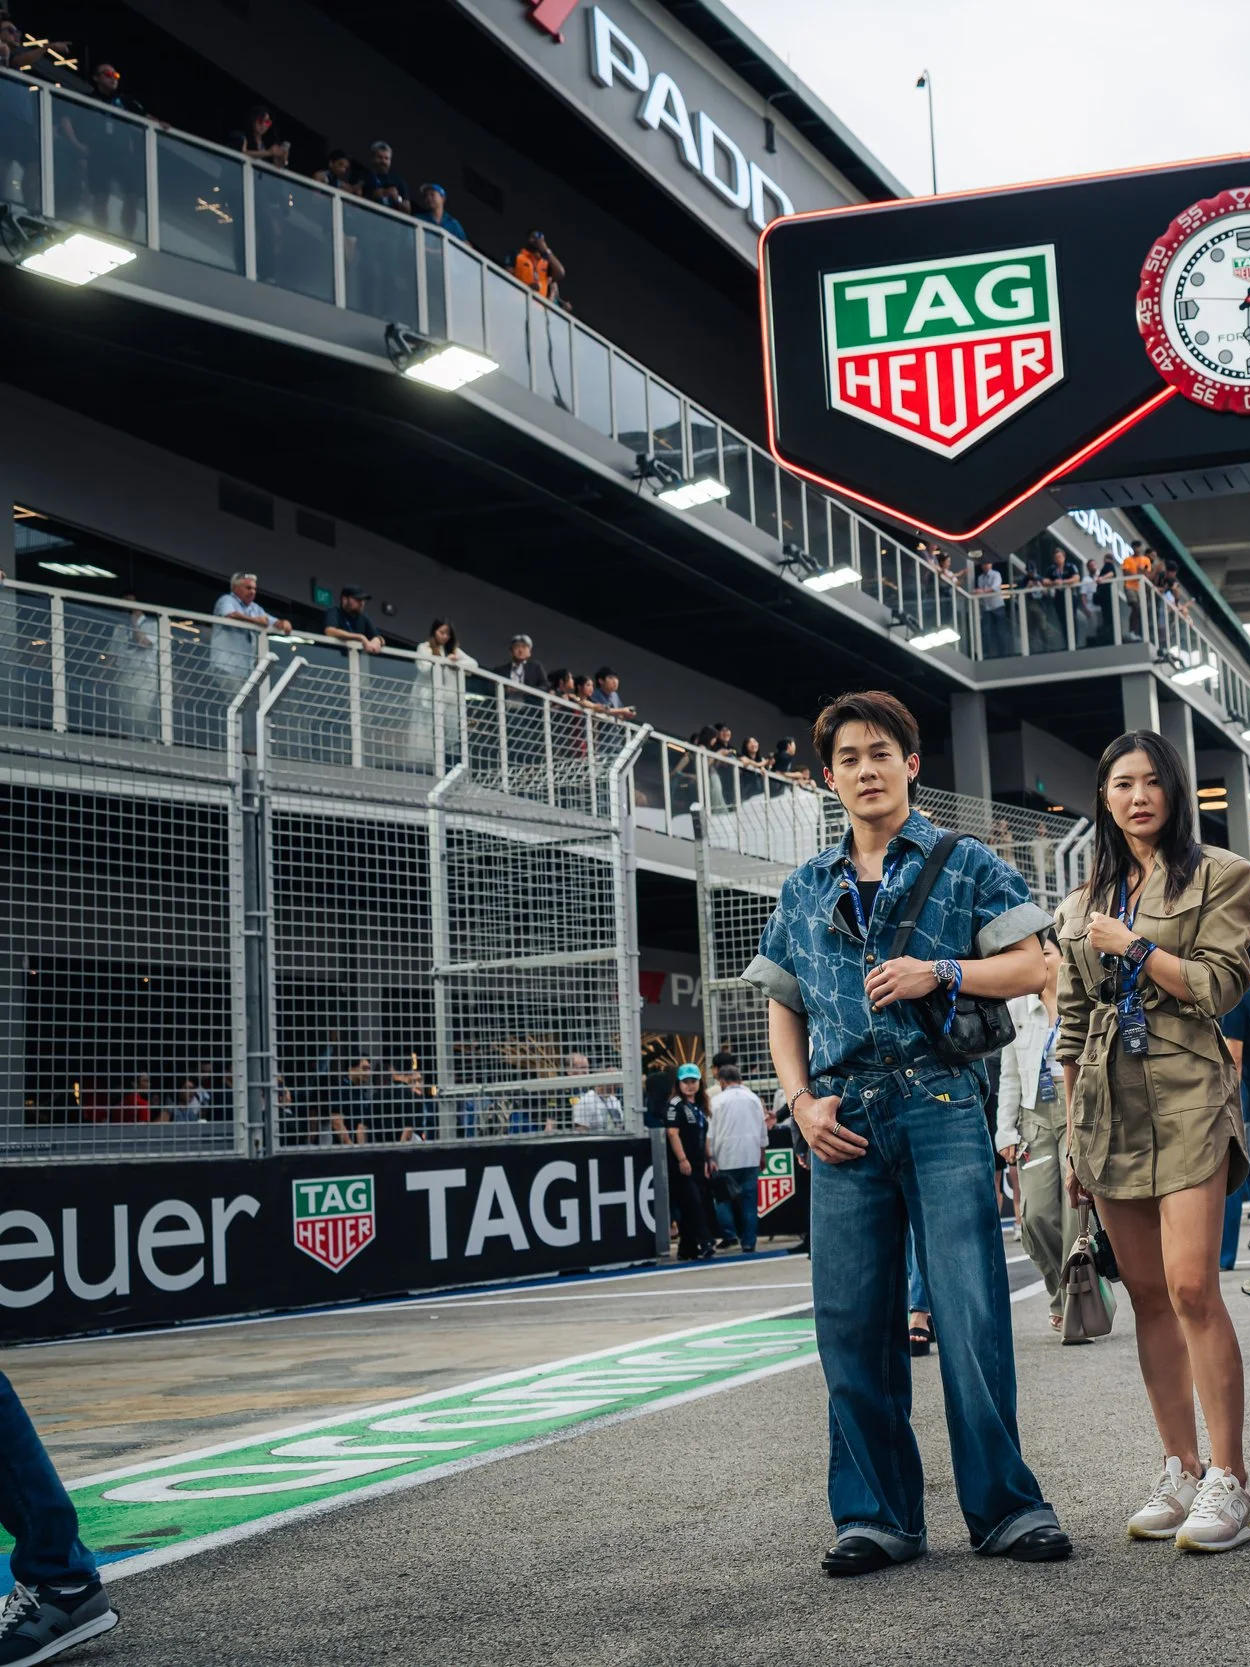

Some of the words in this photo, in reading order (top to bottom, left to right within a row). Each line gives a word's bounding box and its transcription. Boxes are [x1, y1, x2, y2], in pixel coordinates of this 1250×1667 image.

[1177, 205, 1203, 229] 55
[1145, 245, 1167, 272] 50
[845, 264, 1036, 338] TAG
[1137, 297, 1152, 325] 45
[1151, 346, 1174, 371] 40
[845, 337, 1047, 440] HEUER
[1191, 382, 1219, 405] 35
[300, 1181, 367, 1214] TAG
[0, 1194, 261, 1309] euer
[299, 1218, 371, 1265] HEUER
[100, 1330, 818, 1502] aramco
